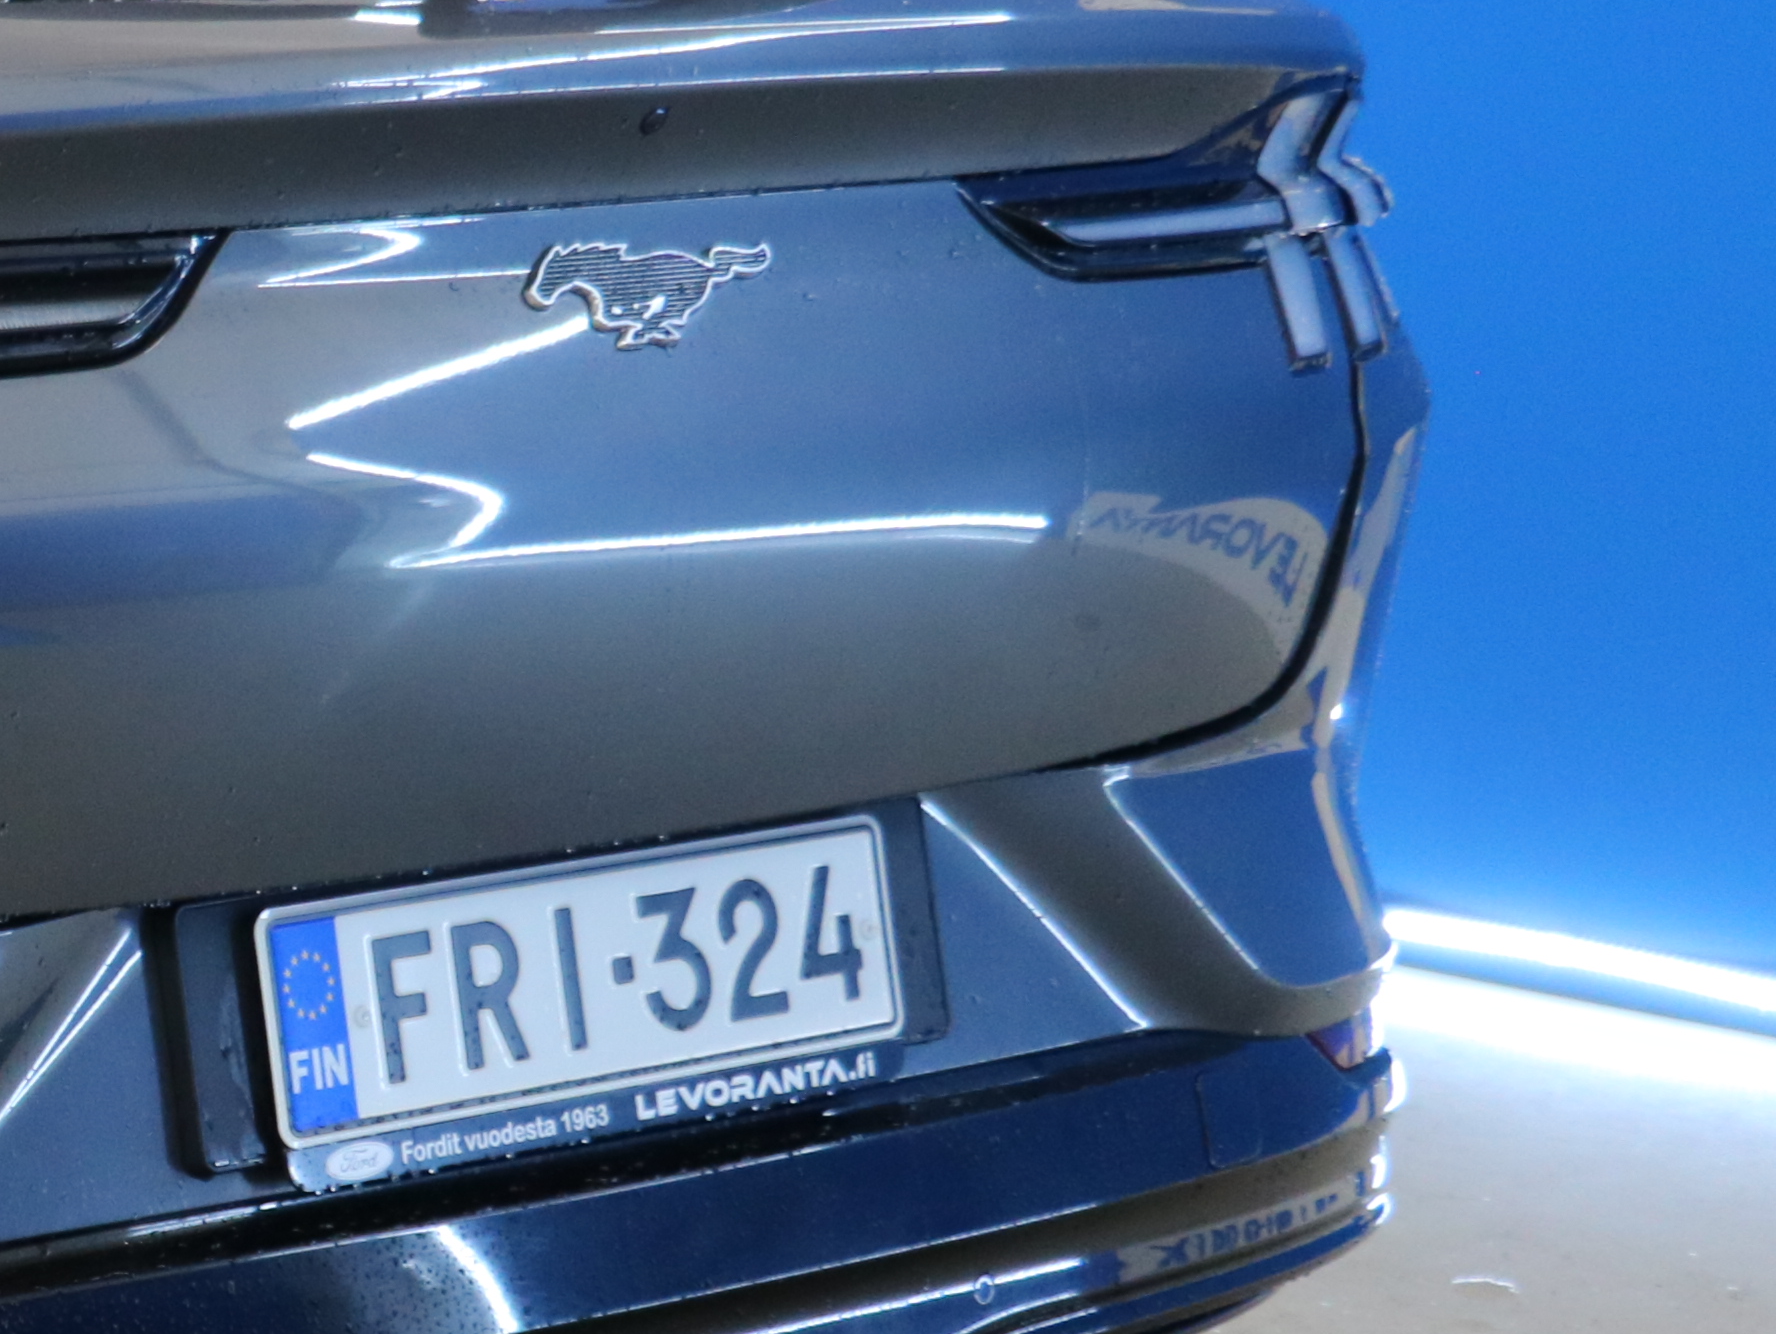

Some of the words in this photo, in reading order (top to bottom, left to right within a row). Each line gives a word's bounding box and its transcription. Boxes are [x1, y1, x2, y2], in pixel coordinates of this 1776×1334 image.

[371, 865, 864, 1084] FRI-324
[288, 1043, 349, 1095] FIN
[633, 1051, 876, 1121] LEVORANTA.fi
[400, 1133, 463, 1166] Fordit
[465, 1120, 558, 1153] vuodesta
[560, 1104, 610, 1134] 1963
